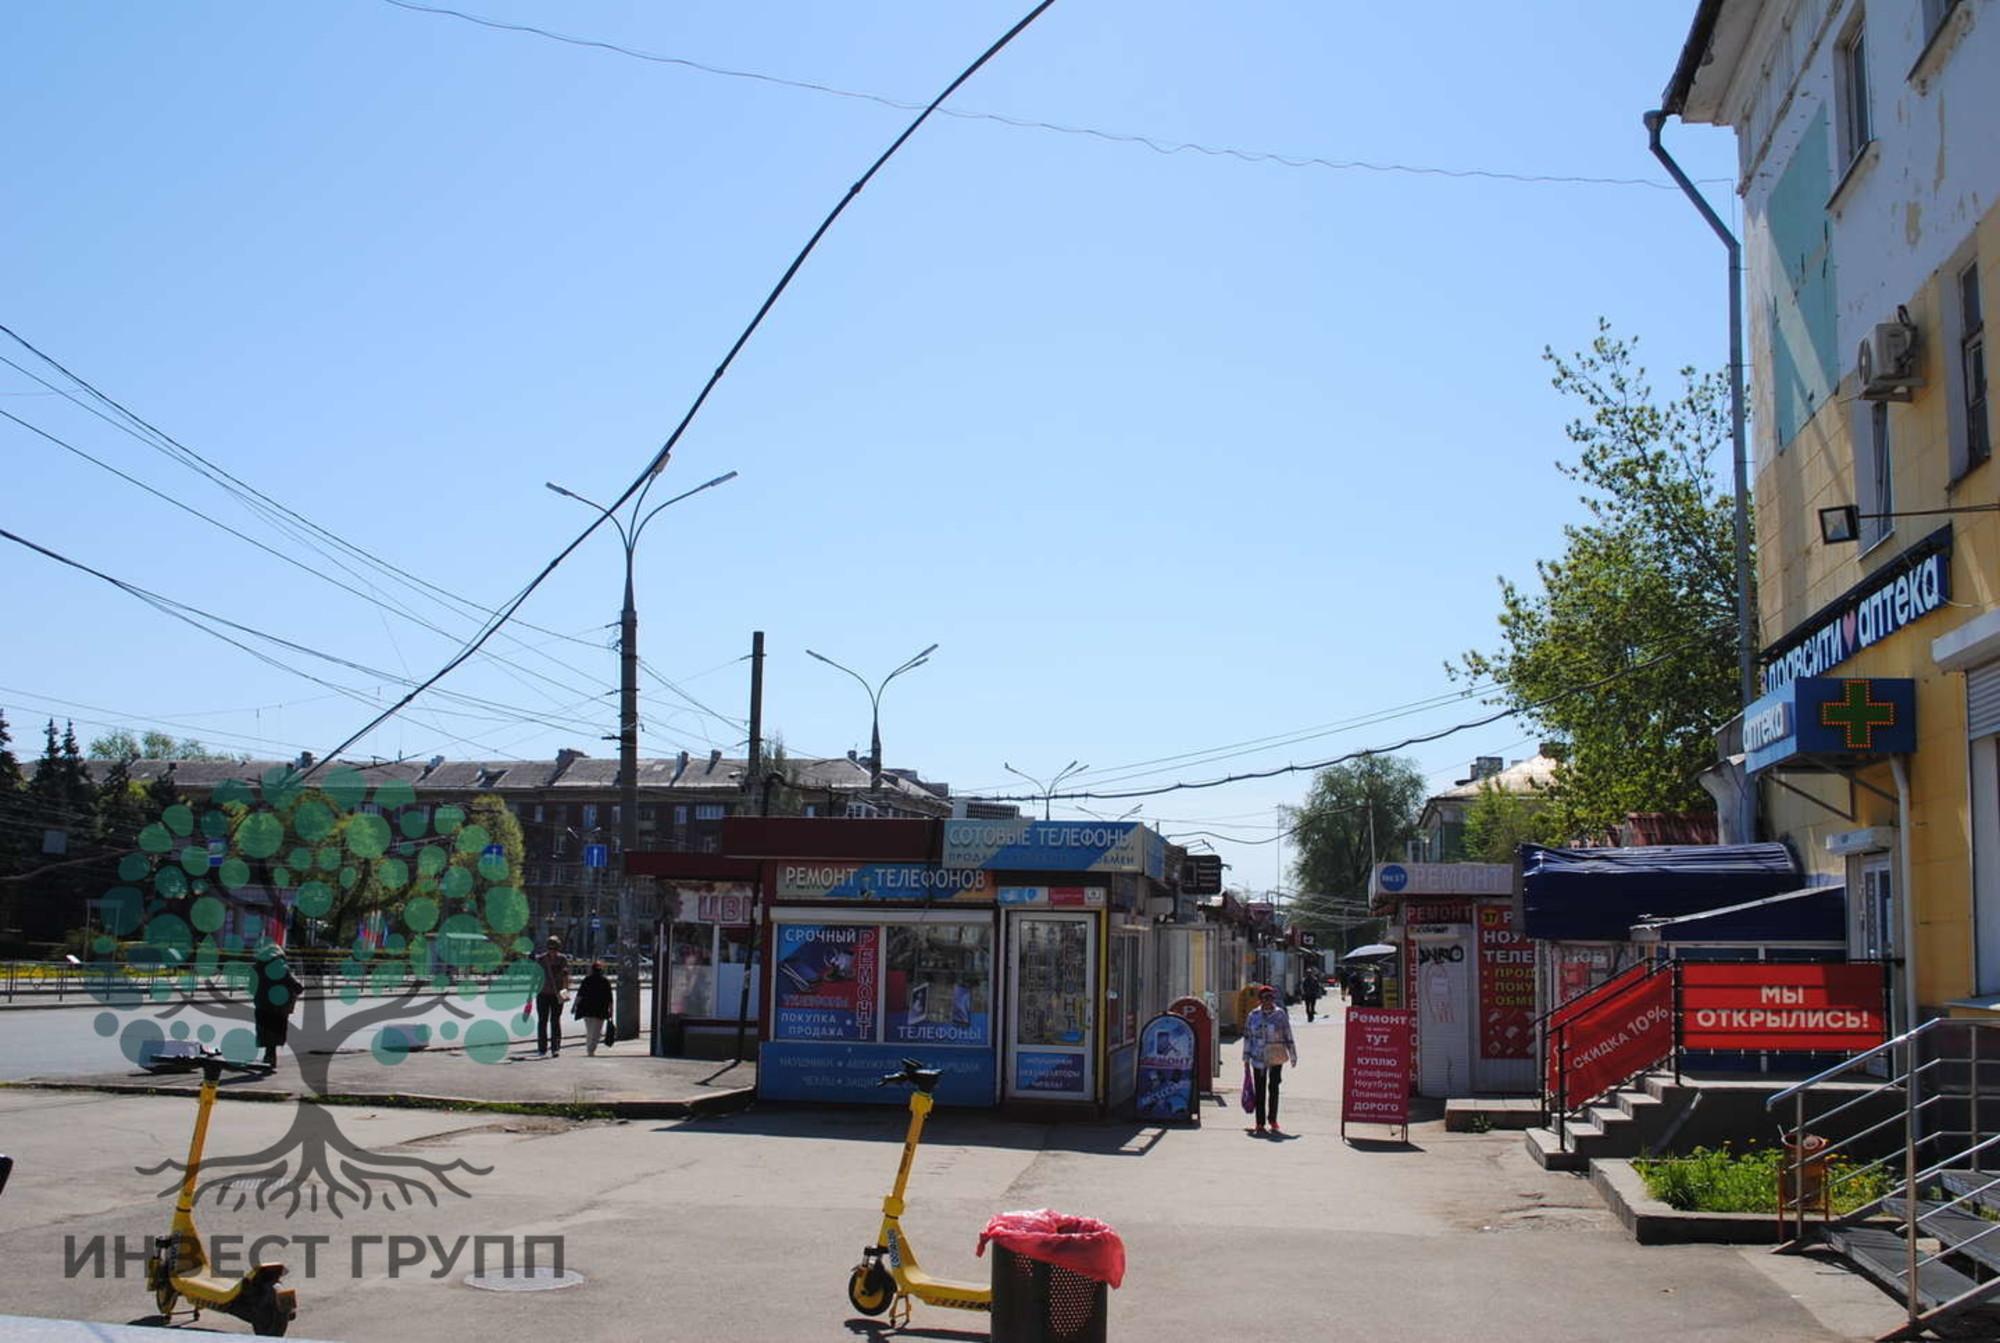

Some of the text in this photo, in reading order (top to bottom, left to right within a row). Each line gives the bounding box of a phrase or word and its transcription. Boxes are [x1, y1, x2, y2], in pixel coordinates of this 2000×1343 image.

[1858, 554, 1939, 648] аптека
[1743, 702, 1784, 750] аптека
[949, 826, 1135, 847] СОТОВЫЕ ТЕЛЕФОНЫ
[785, 867, 985, 889] РЕМОНТ ТЕЛЕФОНОВ
[1407, 906, 1473, 921] РЕМОНТ
[785, 928, 856, 943] СРОЧНЫЙ
[856, 929, 874, 1040] РЕМОНТ
[1761, 986, 1804, 1004] МЫ
[780, 1011, 836, 1023] ПОКУПКА
[1349, 1011, 1408, 1025] Ремонт
[1696, 1009, 1869, 1028] ОТКРЫЛИСЬ!
[788, 1025, 844, 1037] ПРОДАЖА
[897, 1025, 981, 1040] ТЕЛЕФОНЫ
[1573, 1005, 1669, 1068] СКИДКА 10%
